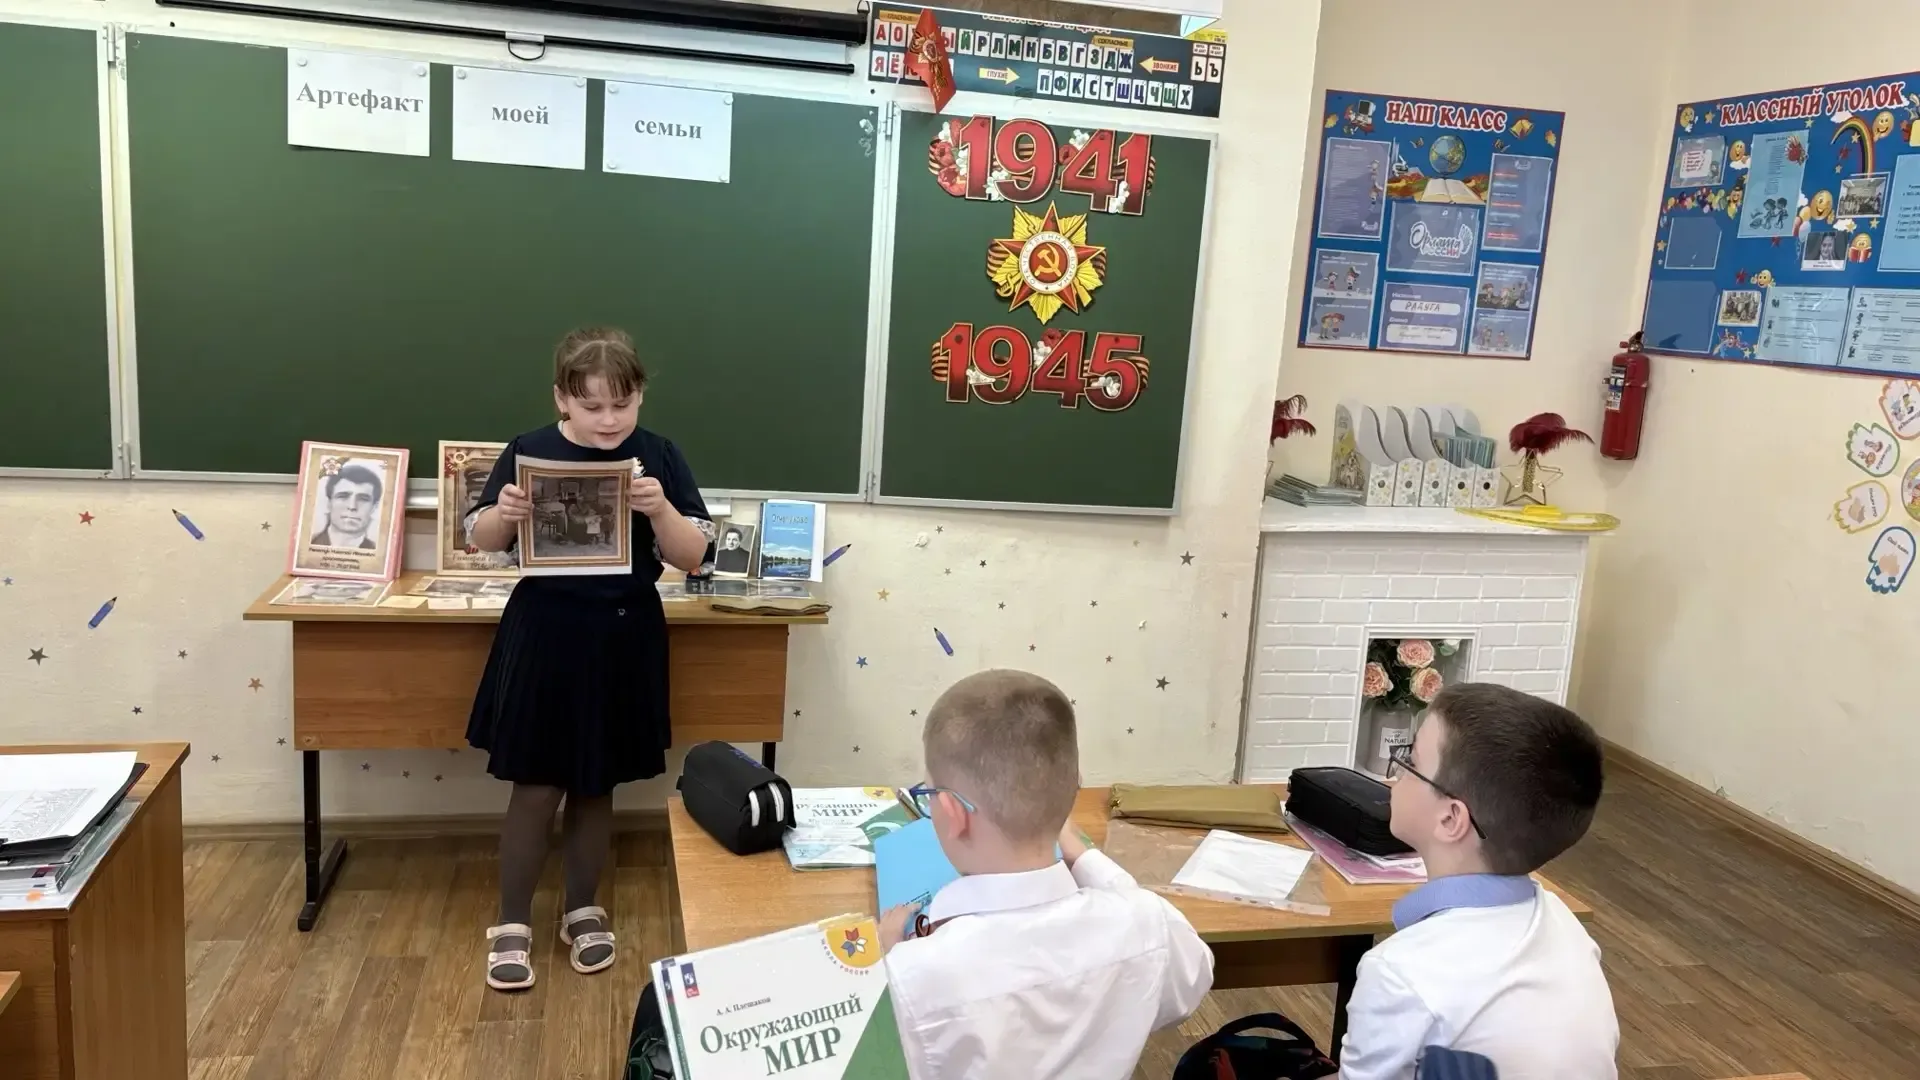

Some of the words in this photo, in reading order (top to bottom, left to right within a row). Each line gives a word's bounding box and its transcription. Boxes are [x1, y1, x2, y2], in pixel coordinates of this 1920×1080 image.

[1097, 38, 1129, 47] СОГЛАСНЫЕ
[986, 70, 1009, 79] ГЛУХИЕ
[1153, 62, 1178, 71] ЗВОНКИЕ
[296, 83, 424, 114] Артефакт
[491, 104, 550, 125] моей
[634, 117, 703, 140] семьи
[1386, 102, 1436, 125] НАШ
[1438, 106, 1506, 132] КЛАСС
[1720, 87, 1824, 126] КЛАССНЫЙ
[1826, 82, 1905, 114] УГОЛОК
[959, 114, 1152, 216] 1941
[1405, 301, 1440, 312] РАДУГА
[940, 322, 1144, 411] 1945
[812, 808, 863, 817] МИР
[733, 997, 771, 1012] Плешаков
[700, 993, 863, 1054] Окружающий
[761, 1026, 841, 1077] МИР
